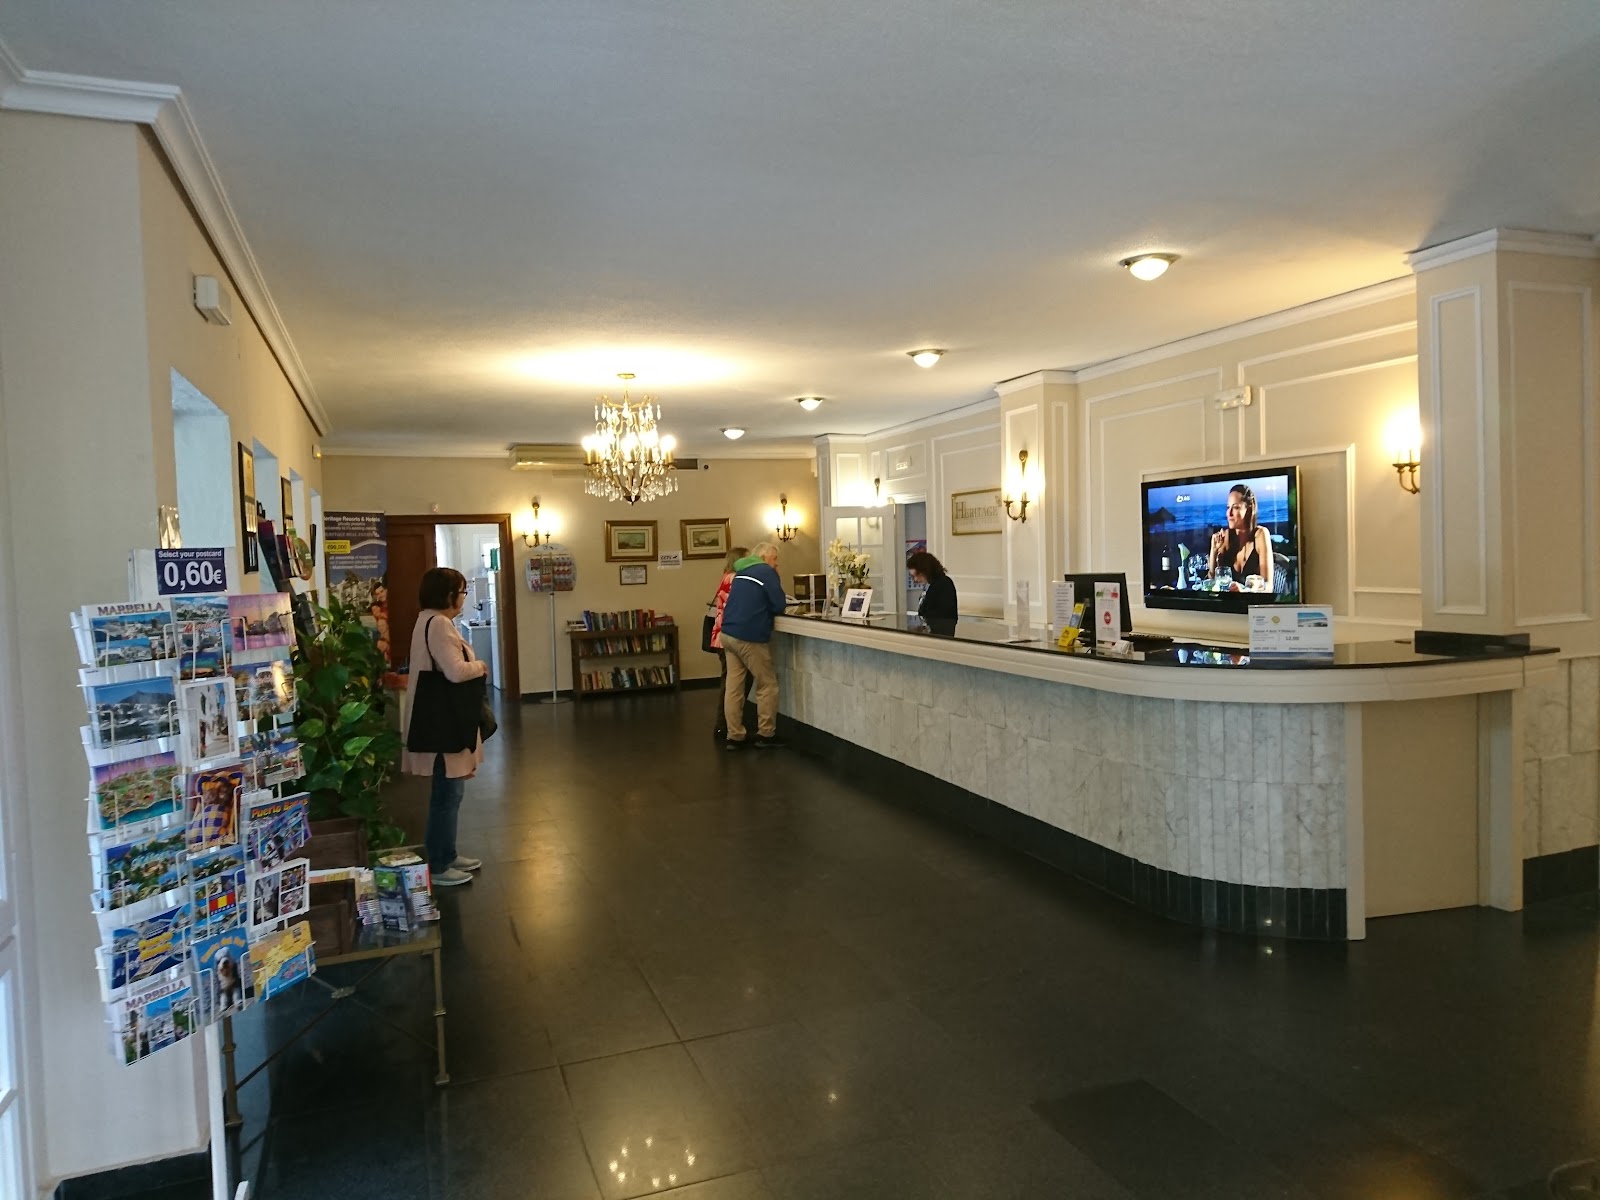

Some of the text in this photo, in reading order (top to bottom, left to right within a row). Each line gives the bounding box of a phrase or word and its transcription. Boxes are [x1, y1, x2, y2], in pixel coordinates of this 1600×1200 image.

[196, 550, 222, 558] postcard
[164, 561, 223, 591] 0,60€
[97, 602, 164, 616] MARBELLA
[252, 805, 282, 819] Puerto
[126, 980, 186, 1010] MARBELLA
